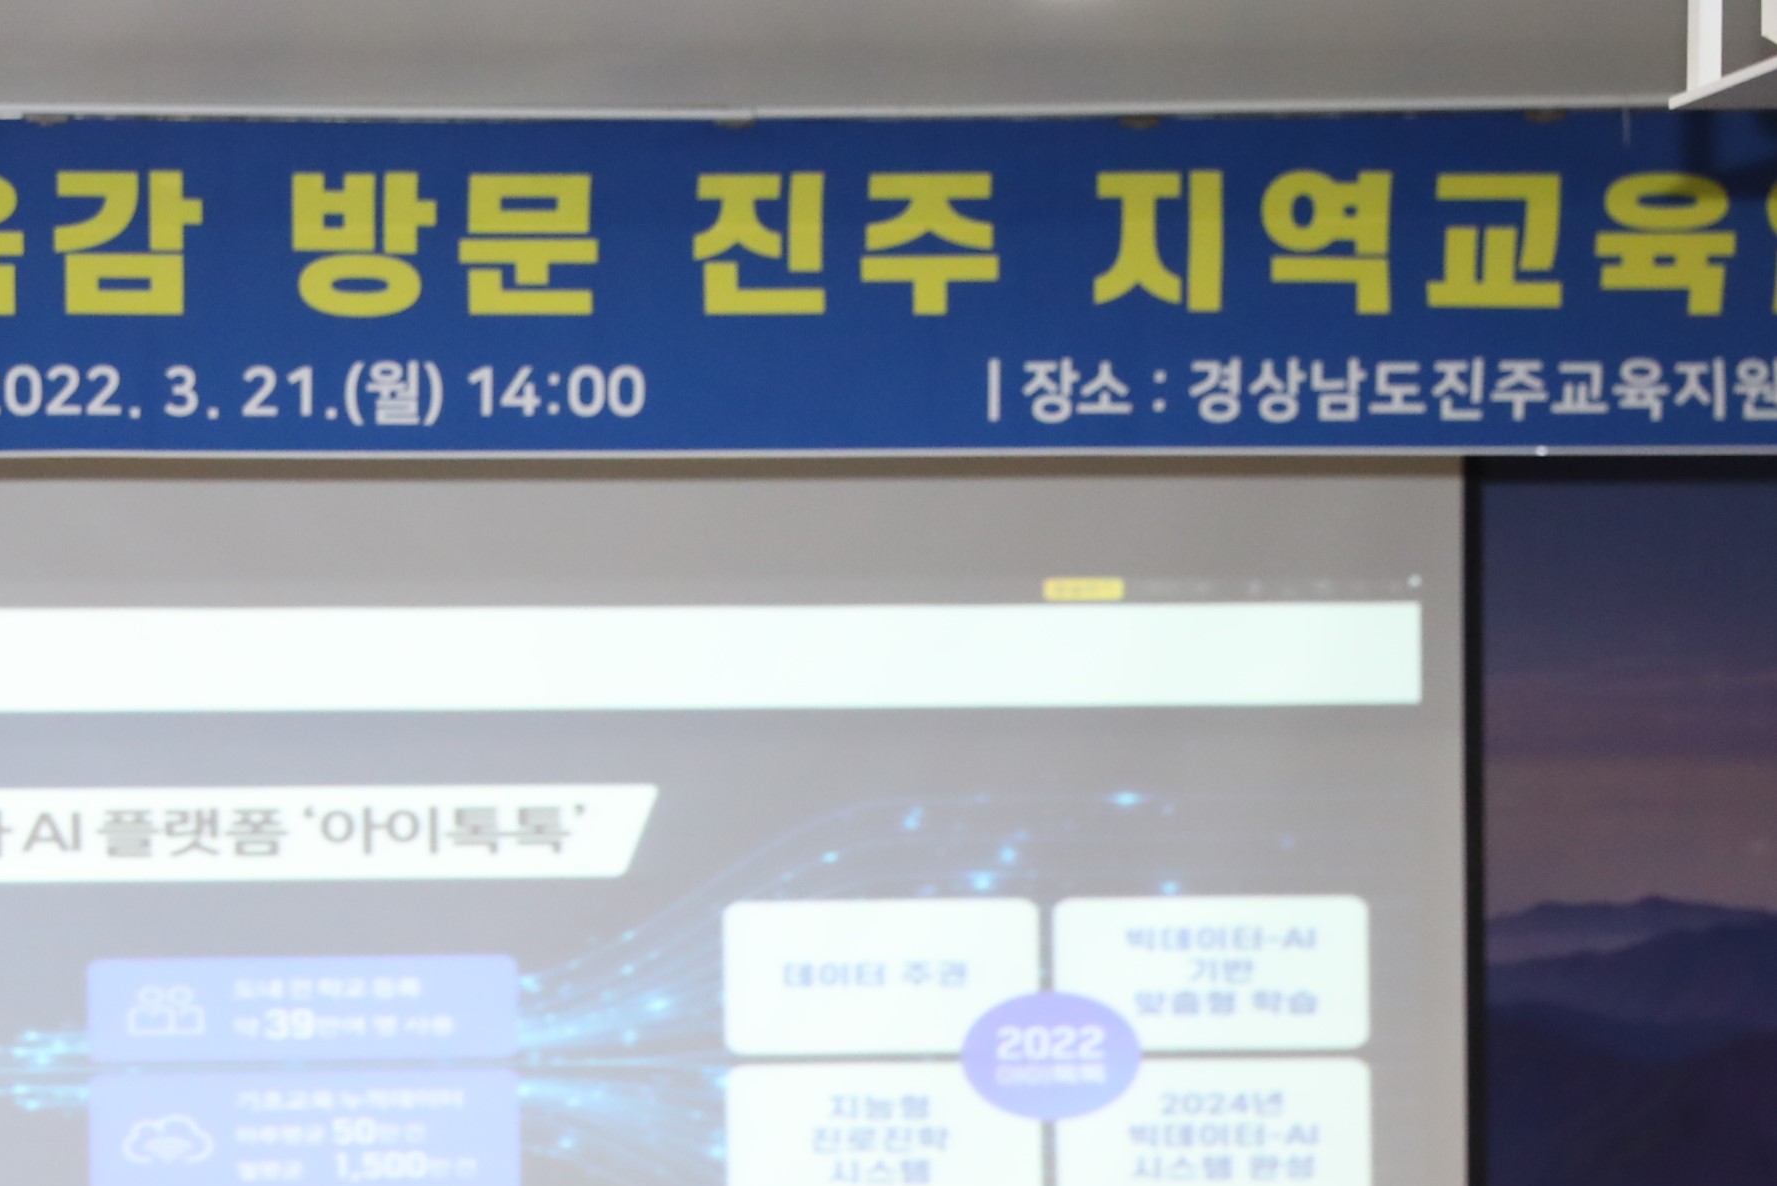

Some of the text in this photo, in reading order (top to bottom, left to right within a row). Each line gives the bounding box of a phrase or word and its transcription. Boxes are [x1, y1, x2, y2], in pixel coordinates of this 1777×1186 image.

[291, 171, 599, 317] 방문
[692, 170, 1000, 316] 진주
[1093, 168, 1777, 316] 지역교육
[163, 364, 220, 420] 3.
[466, 364, 647, 419] 14:00
[1022, 357, 1134, 424] 장소
[21, 812, 83, 857] AI
[96, 805, 290, 858] 플랫폼
[995, 1025, 1106, 1061] 2022
